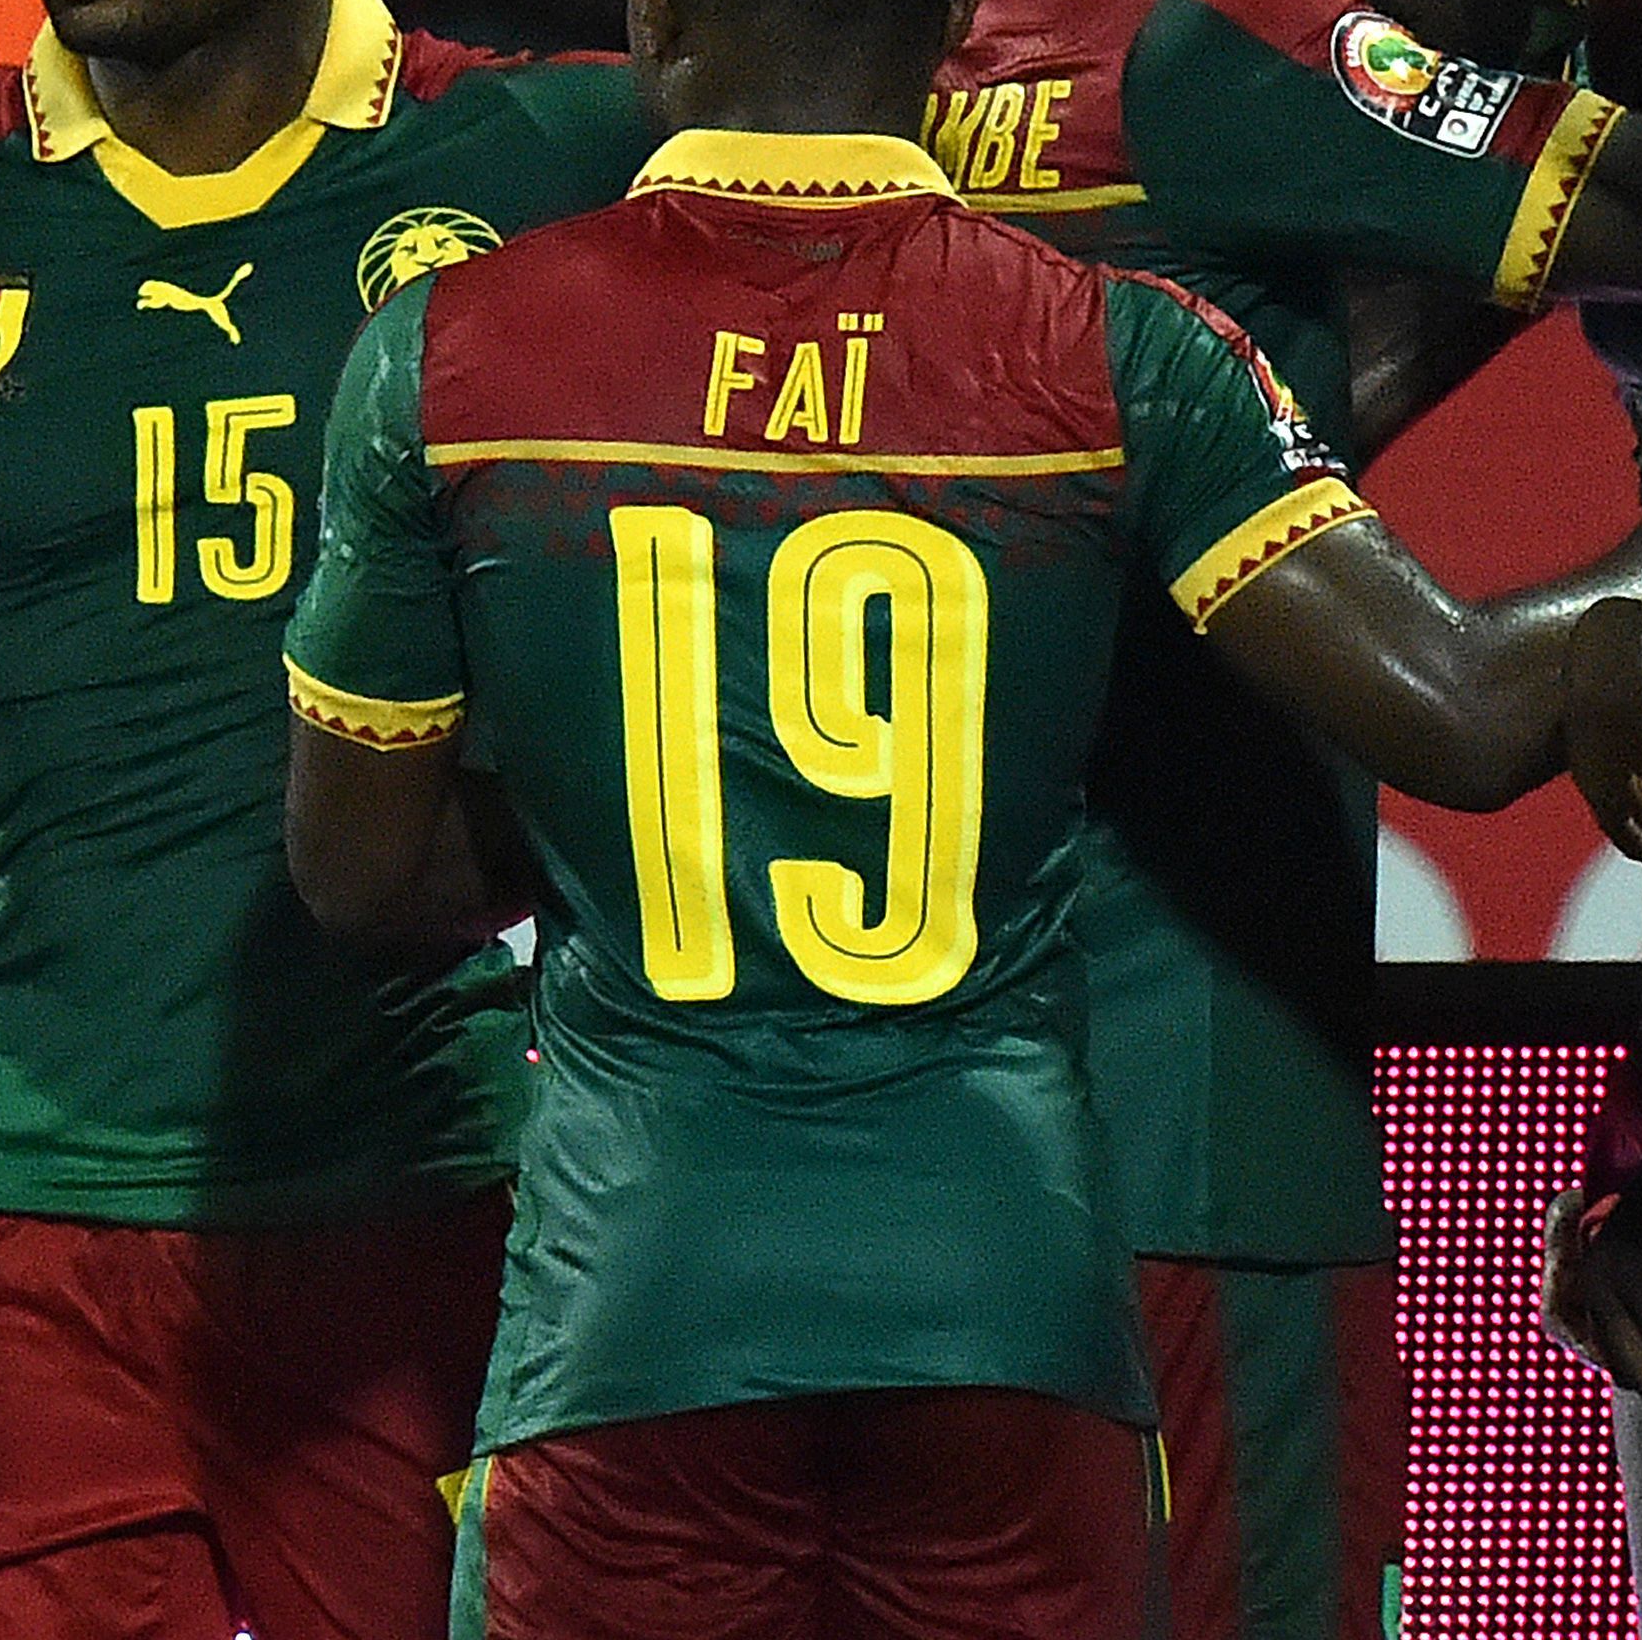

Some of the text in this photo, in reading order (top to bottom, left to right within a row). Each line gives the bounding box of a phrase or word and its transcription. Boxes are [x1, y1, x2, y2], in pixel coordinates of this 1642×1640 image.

[703, 313, 884, 444] FAÏ
[133, 395, 296, 604] 15
[609, 505, 988, 1005] 19
